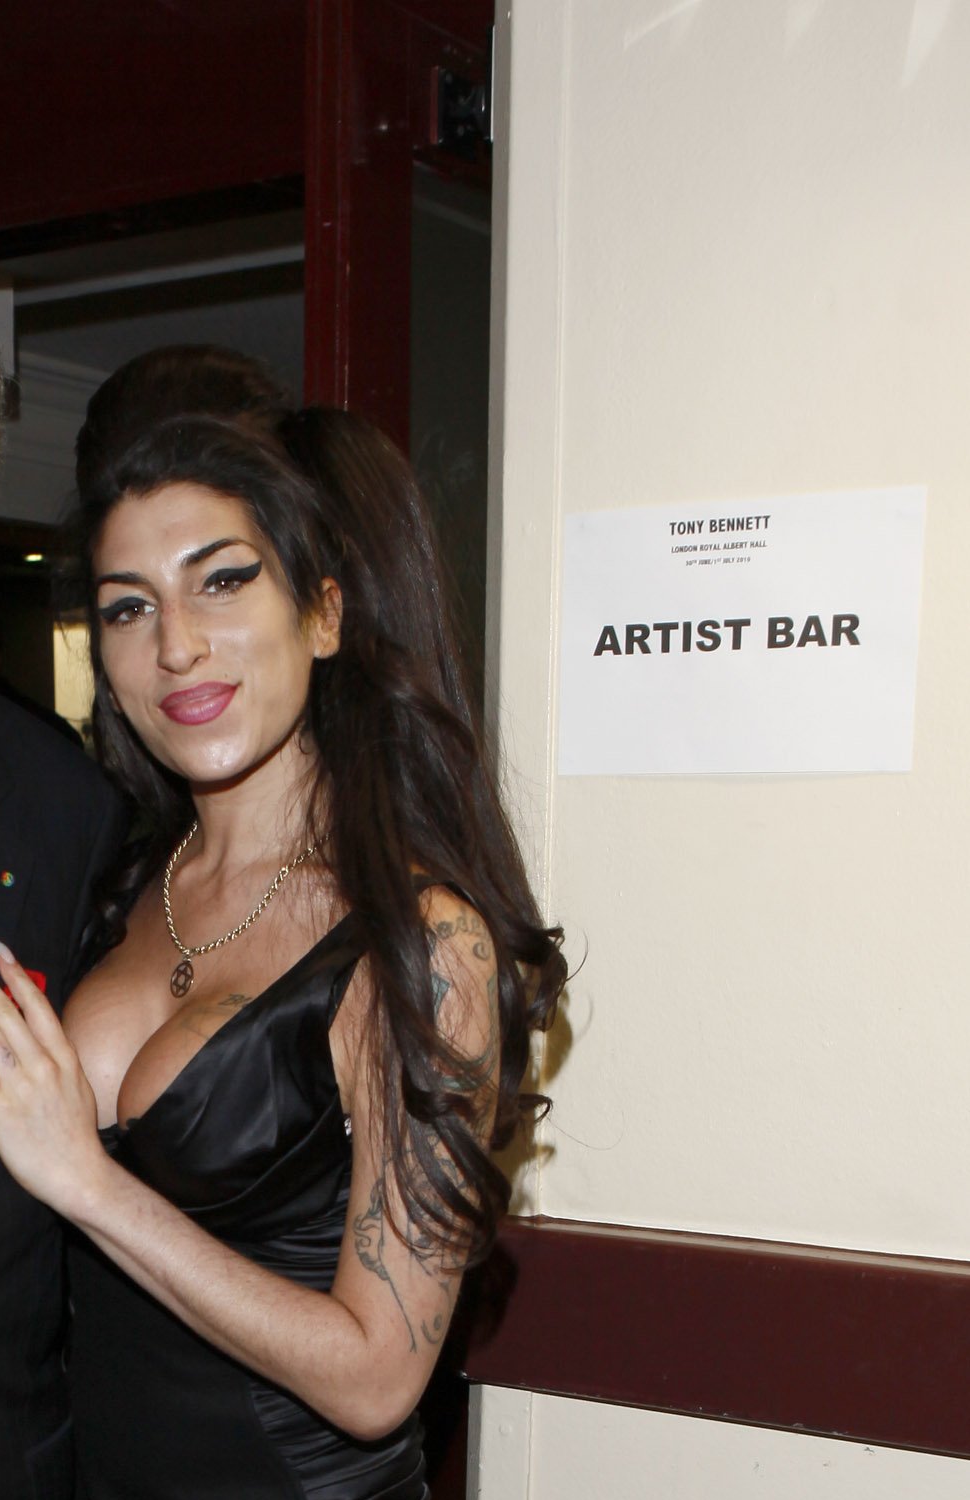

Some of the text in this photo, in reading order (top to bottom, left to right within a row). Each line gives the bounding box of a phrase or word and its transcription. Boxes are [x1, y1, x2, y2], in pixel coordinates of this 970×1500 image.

[670, 515, 771, 536] TONY BENNETT
[671, 540, 767, 554] LONDON ROYAL ALBERT HALL
[593, 613, 860, 656] ARTIST BAR
